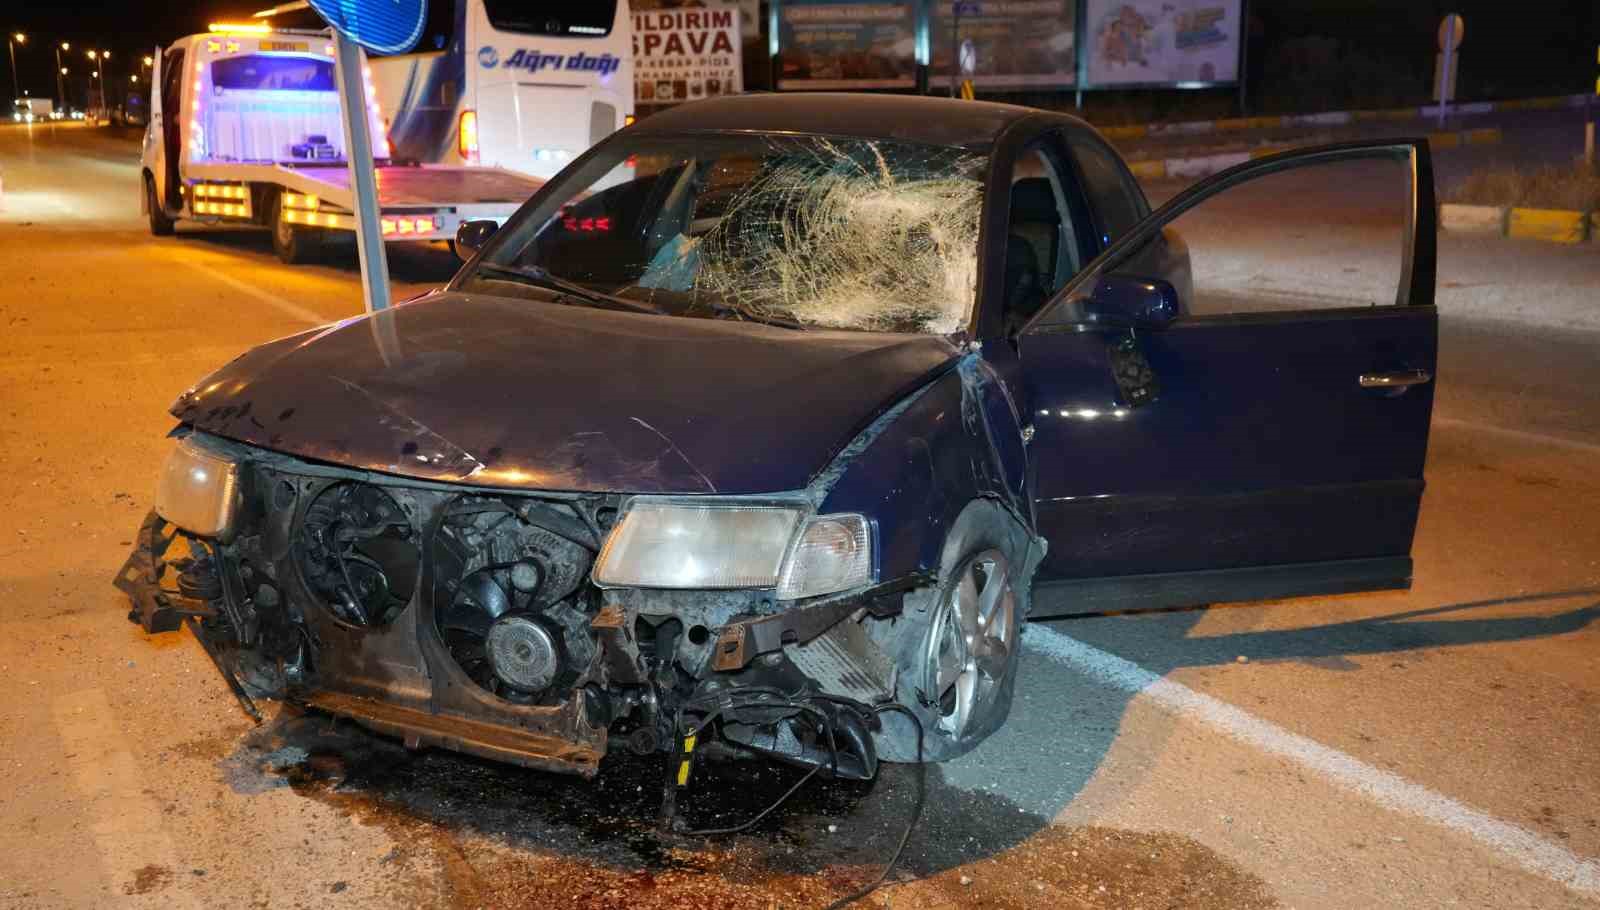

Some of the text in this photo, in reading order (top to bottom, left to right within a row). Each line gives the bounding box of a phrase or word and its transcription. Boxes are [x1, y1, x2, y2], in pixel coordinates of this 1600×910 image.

[631, 11, 732, 31] ILDIRIM
[502, 48, 620, 76] Ağrı dağı
